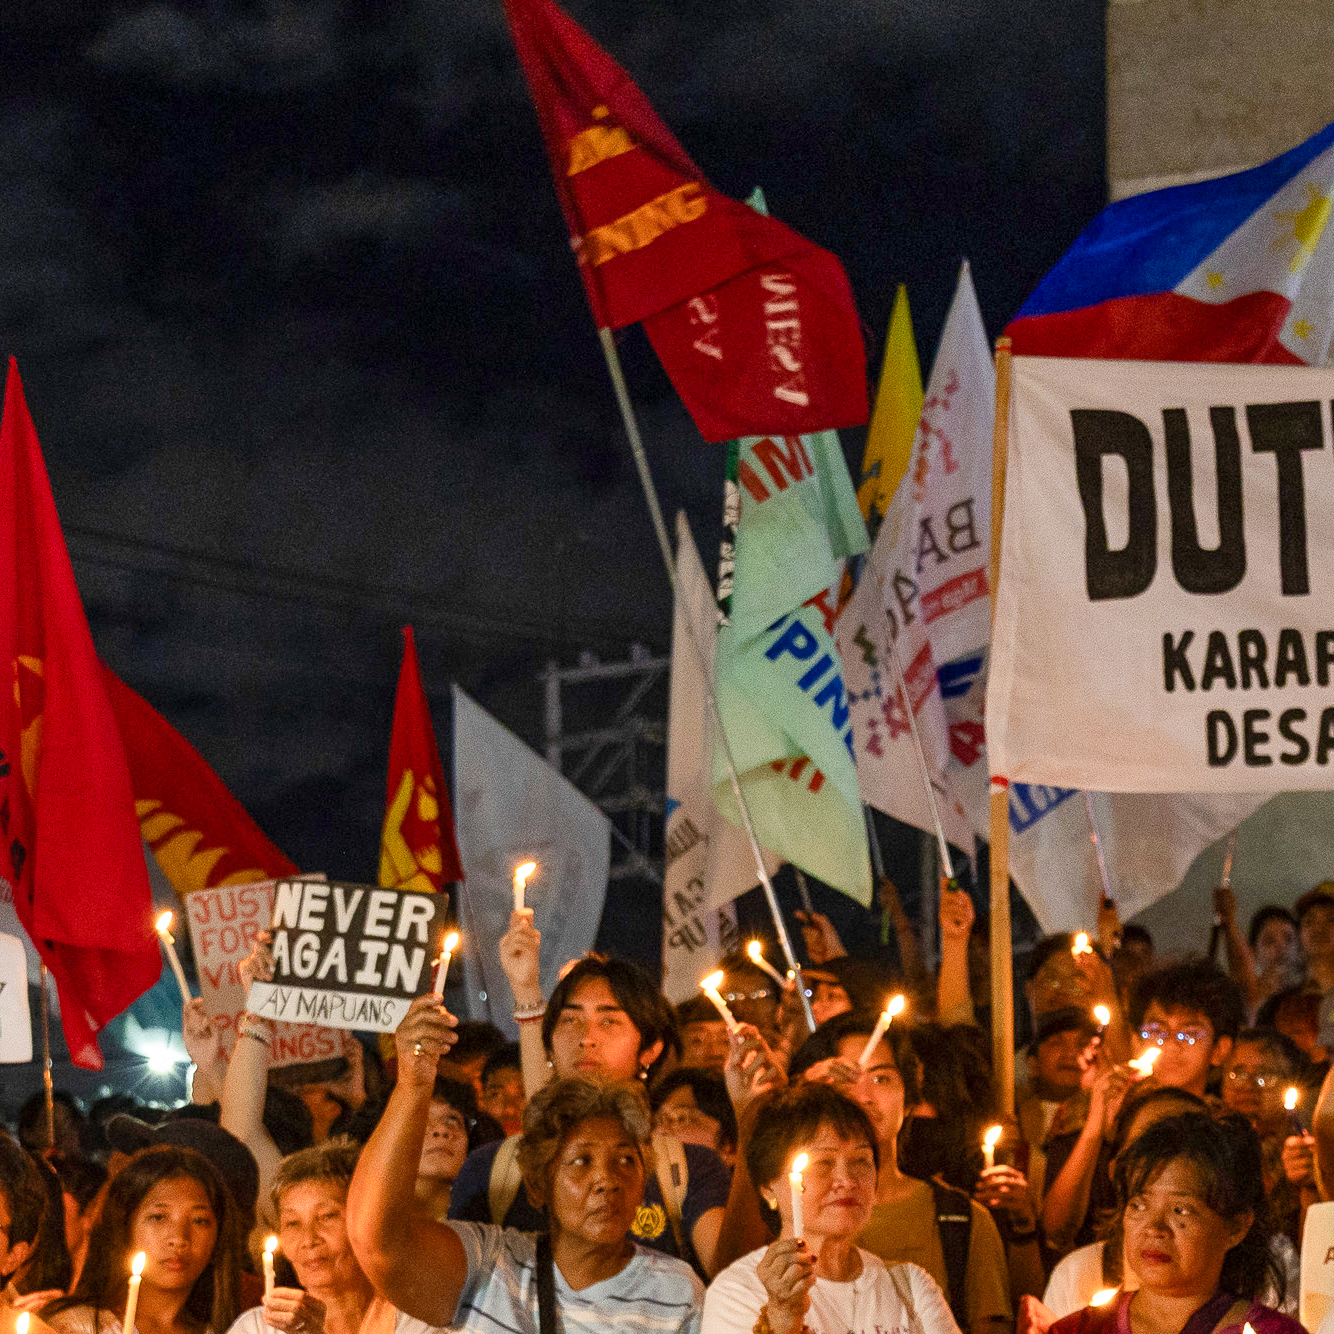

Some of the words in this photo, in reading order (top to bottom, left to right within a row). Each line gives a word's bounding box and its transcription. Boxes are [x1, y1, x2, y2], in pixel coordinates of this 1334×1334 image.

[272, 881, 436, 944] NEVER
[272, 930, 427, 995] AGAIN
[295, 988, 398, 1027] MAPUANS
